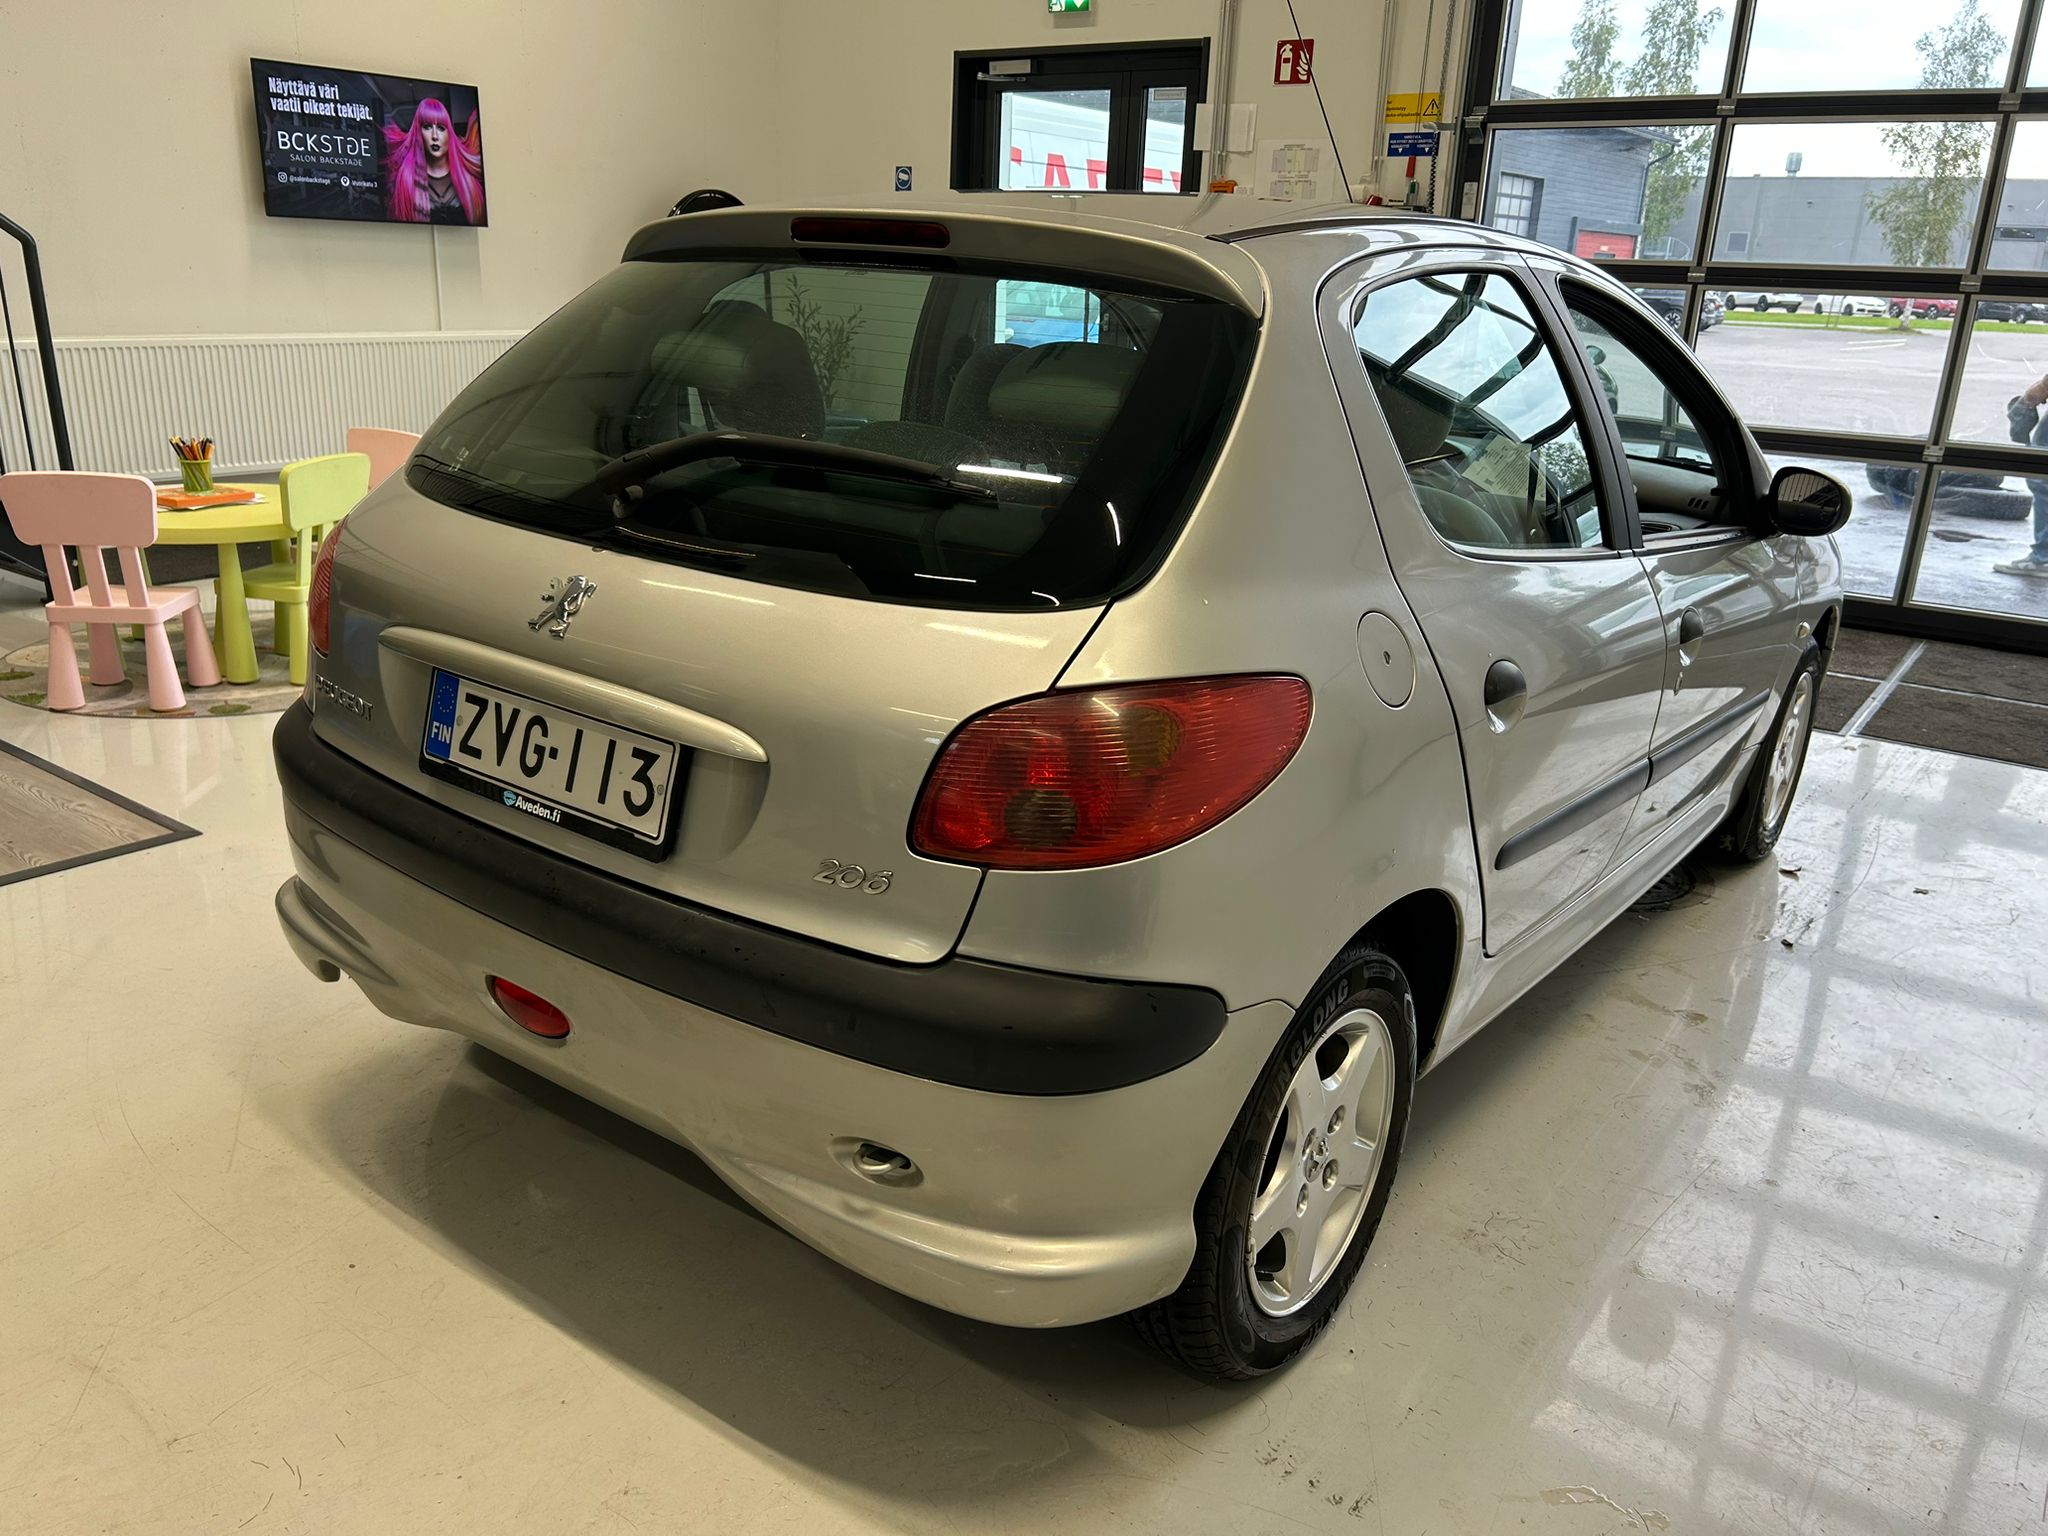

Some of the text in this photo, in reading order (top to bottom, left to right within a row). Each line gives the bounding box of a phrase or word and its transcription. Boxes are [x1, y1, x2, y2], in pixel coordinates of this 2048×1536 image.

[268, 77, 339, 100] Näyttävä väri
[270, 97, 373, 121] vaatii oikeat tekijät.
[290, 153, 363, 167] SALON BACKSTAGE
[315, 673, 374, 721] PEUGEOT
[430, 721, 452, 745] FIN
[459, 692, 661, 818] ZVG-113
[515, 796, 561, 823] Aveden.fi
[812, 858, 893, 895] 206
